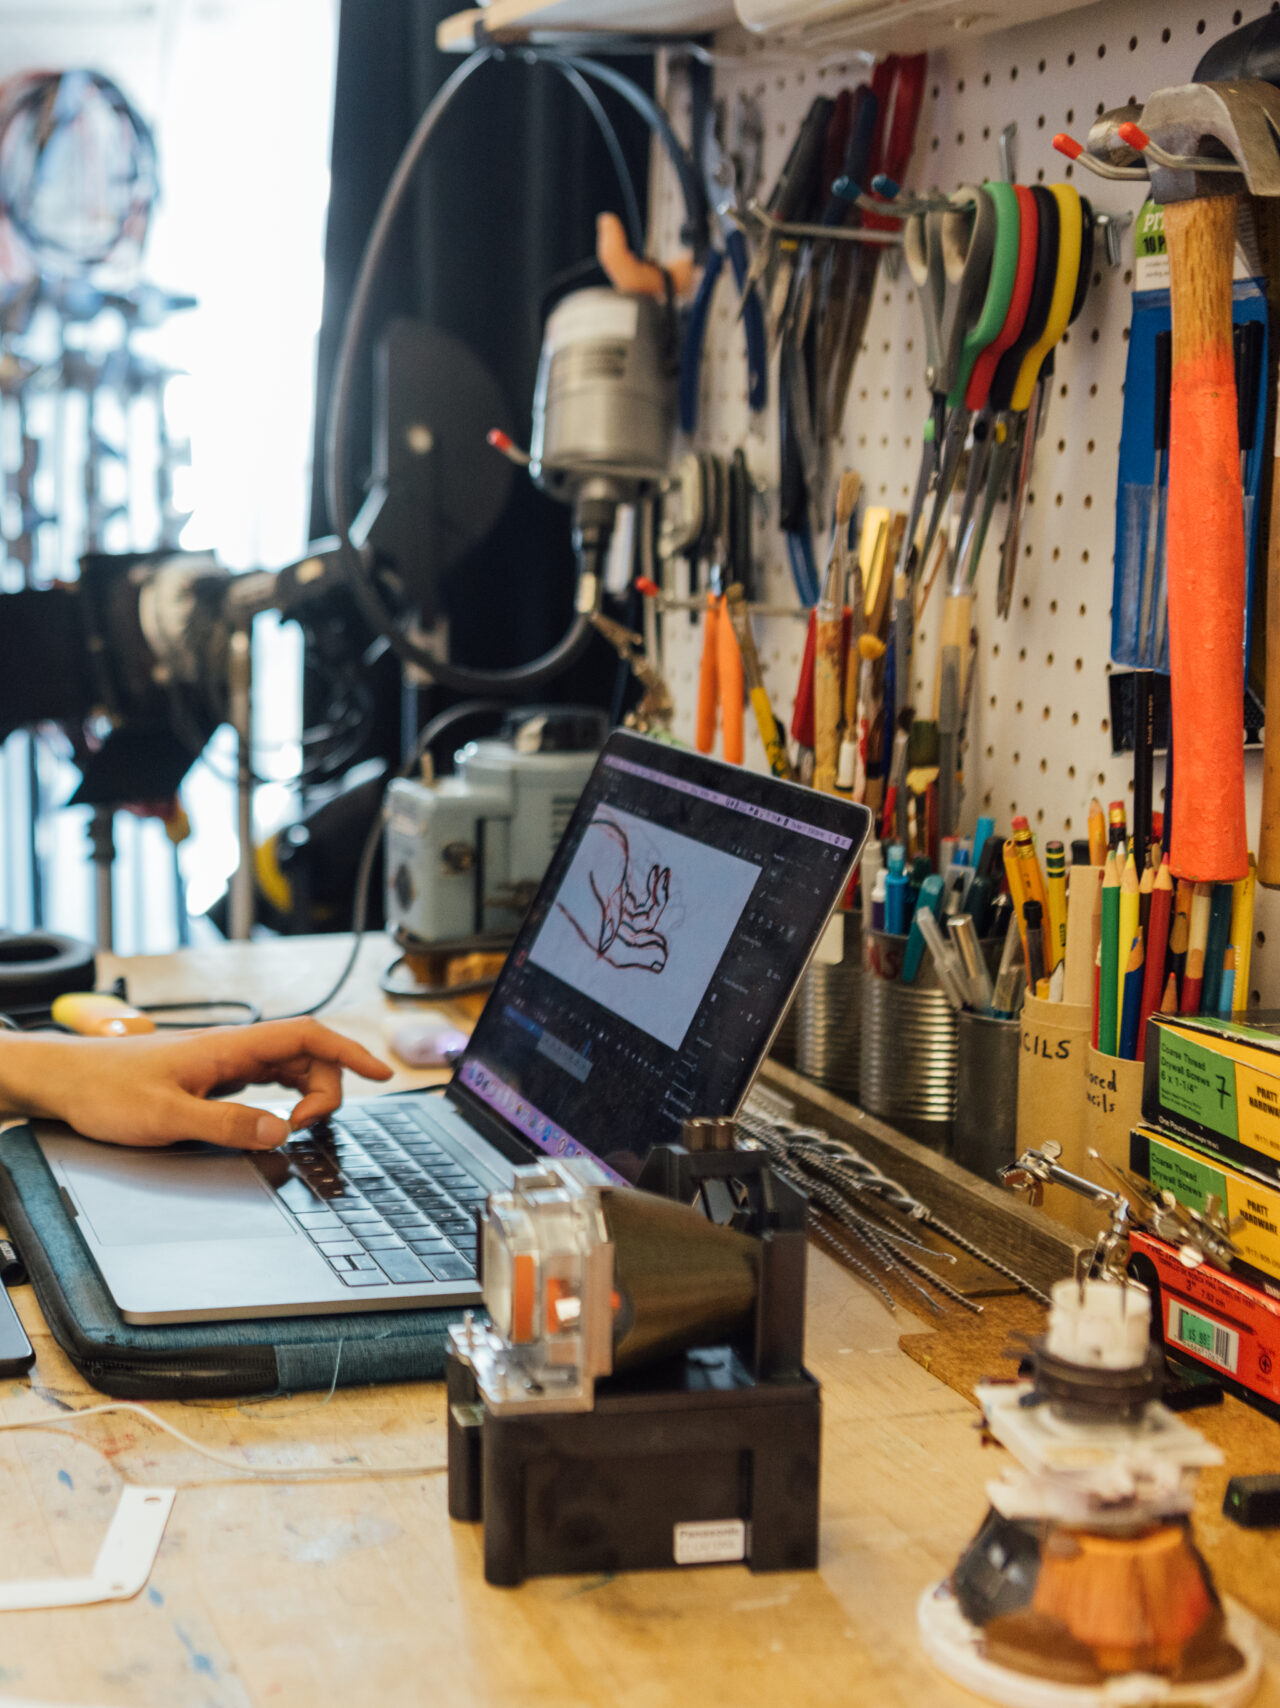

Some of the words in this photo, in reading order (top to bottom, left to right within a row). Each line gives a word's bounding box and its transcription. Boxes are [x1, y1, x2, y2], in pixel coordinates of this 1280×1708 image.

[1161, 1042, 1182, 1060] Coarse
[1183, 1052, 1206, 1071] Thread
[1256, 1086, 1278, 1104] PRATT
[1246, 1199, 1269, 1217] PRATT
